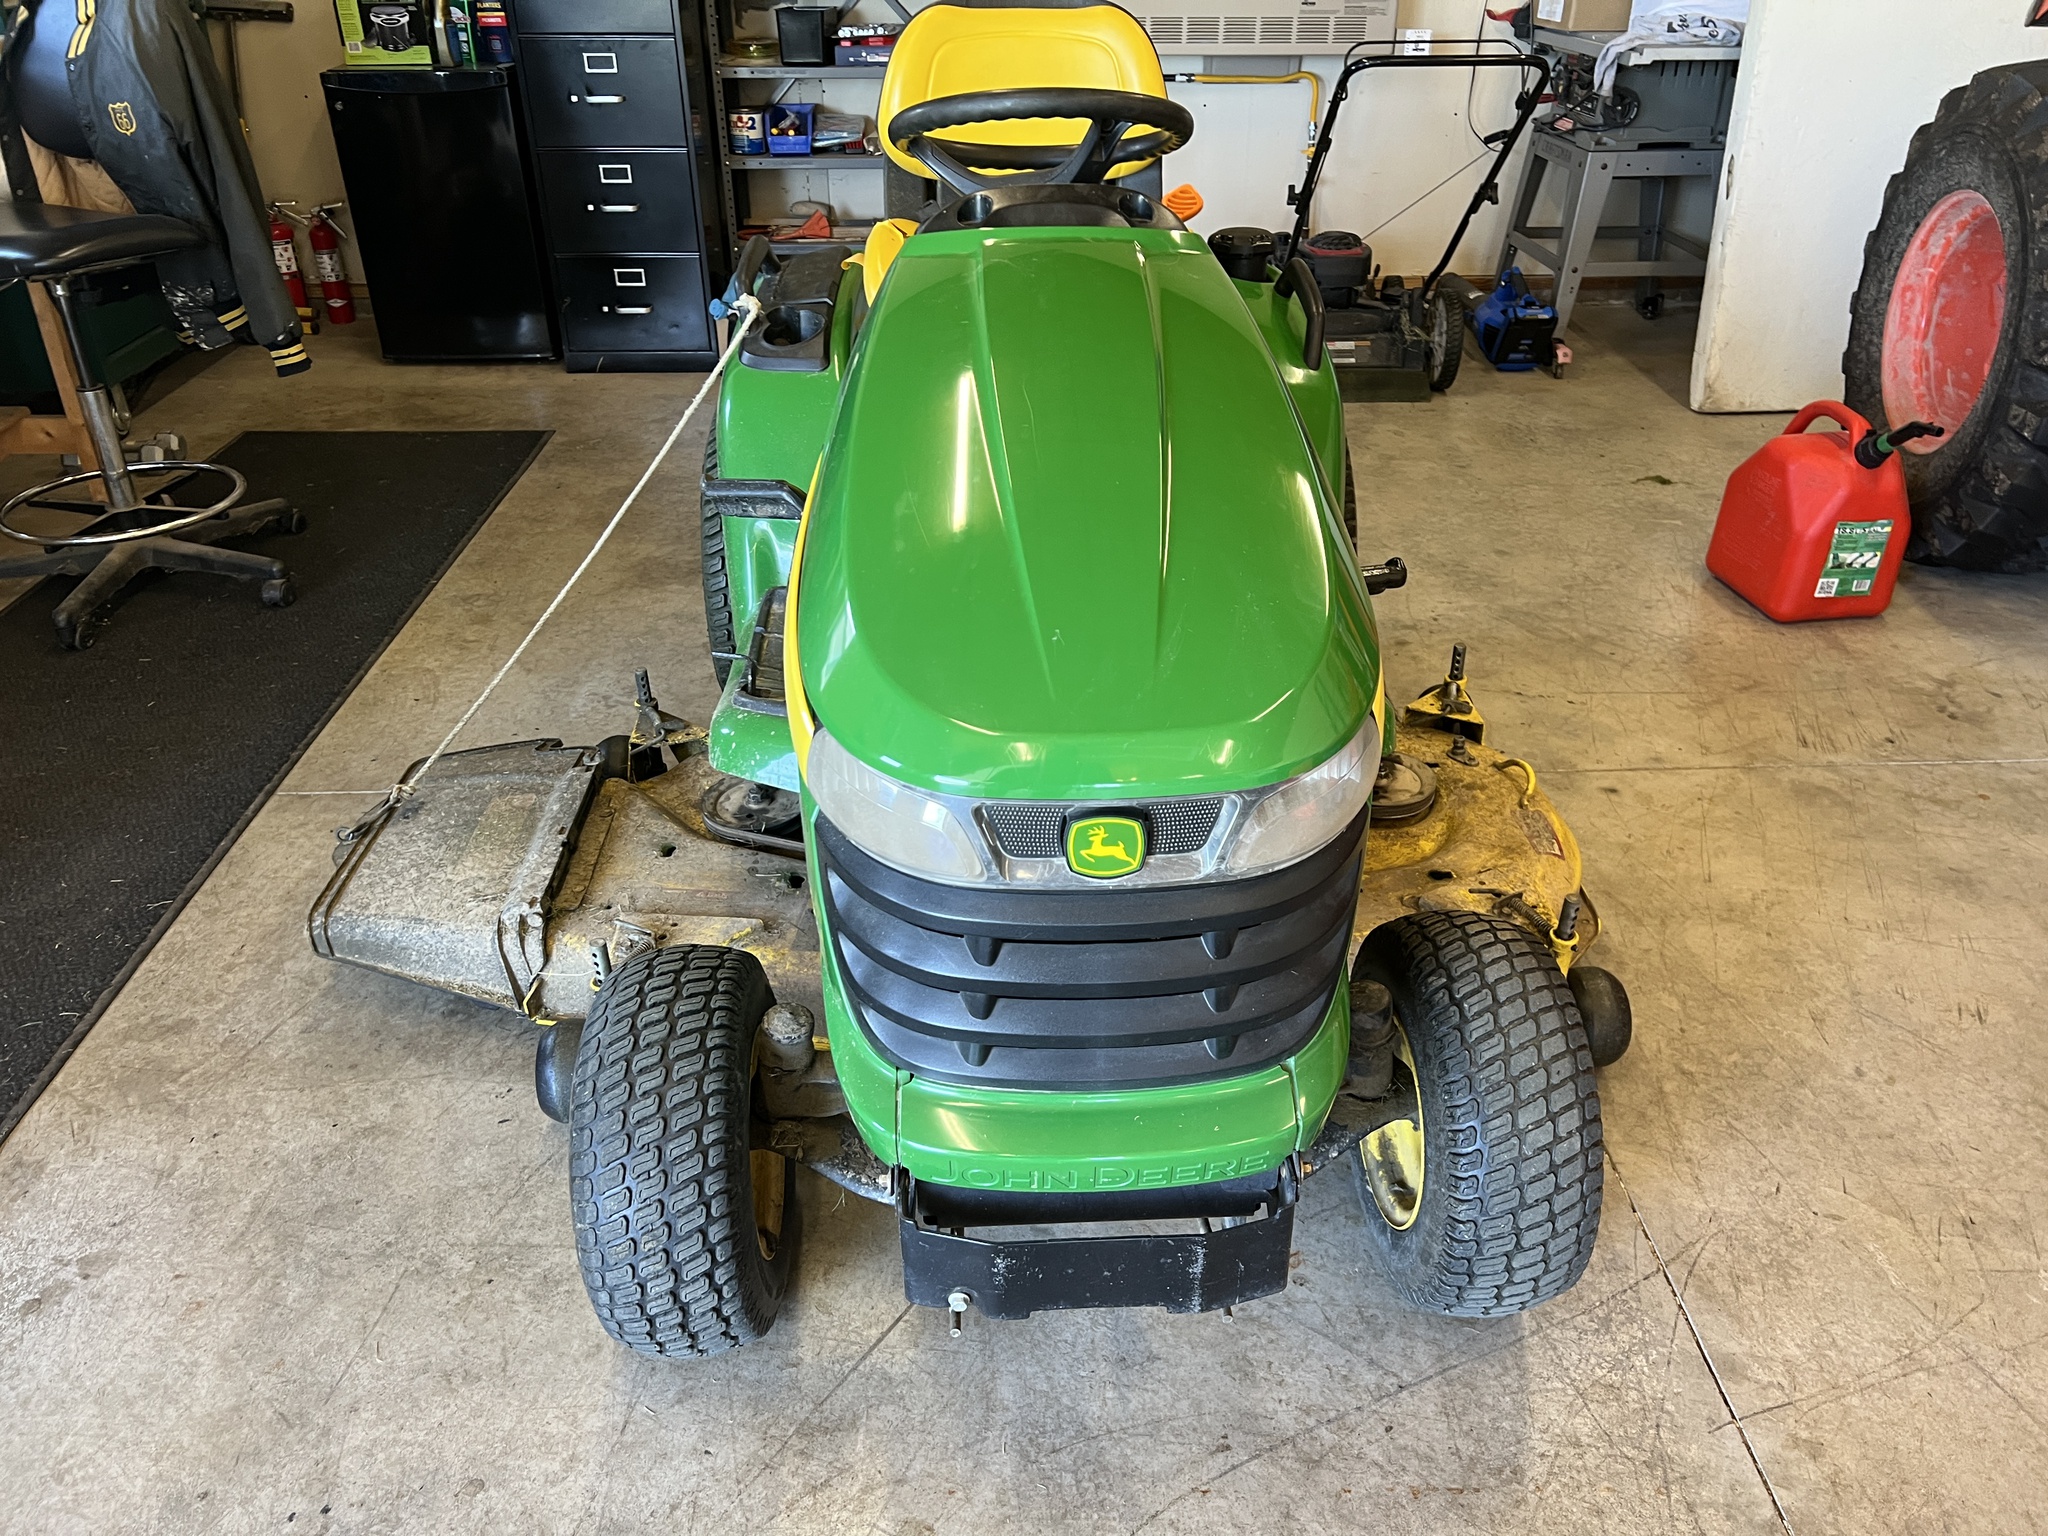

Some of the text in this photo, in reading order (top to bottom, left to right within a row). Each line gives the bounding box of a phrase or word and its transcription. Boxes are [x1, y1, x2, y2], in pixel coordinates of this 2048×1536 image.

[116, 112, 131, 130] 66
[930, 1151, 1270, 1190] JOHN DEERE
